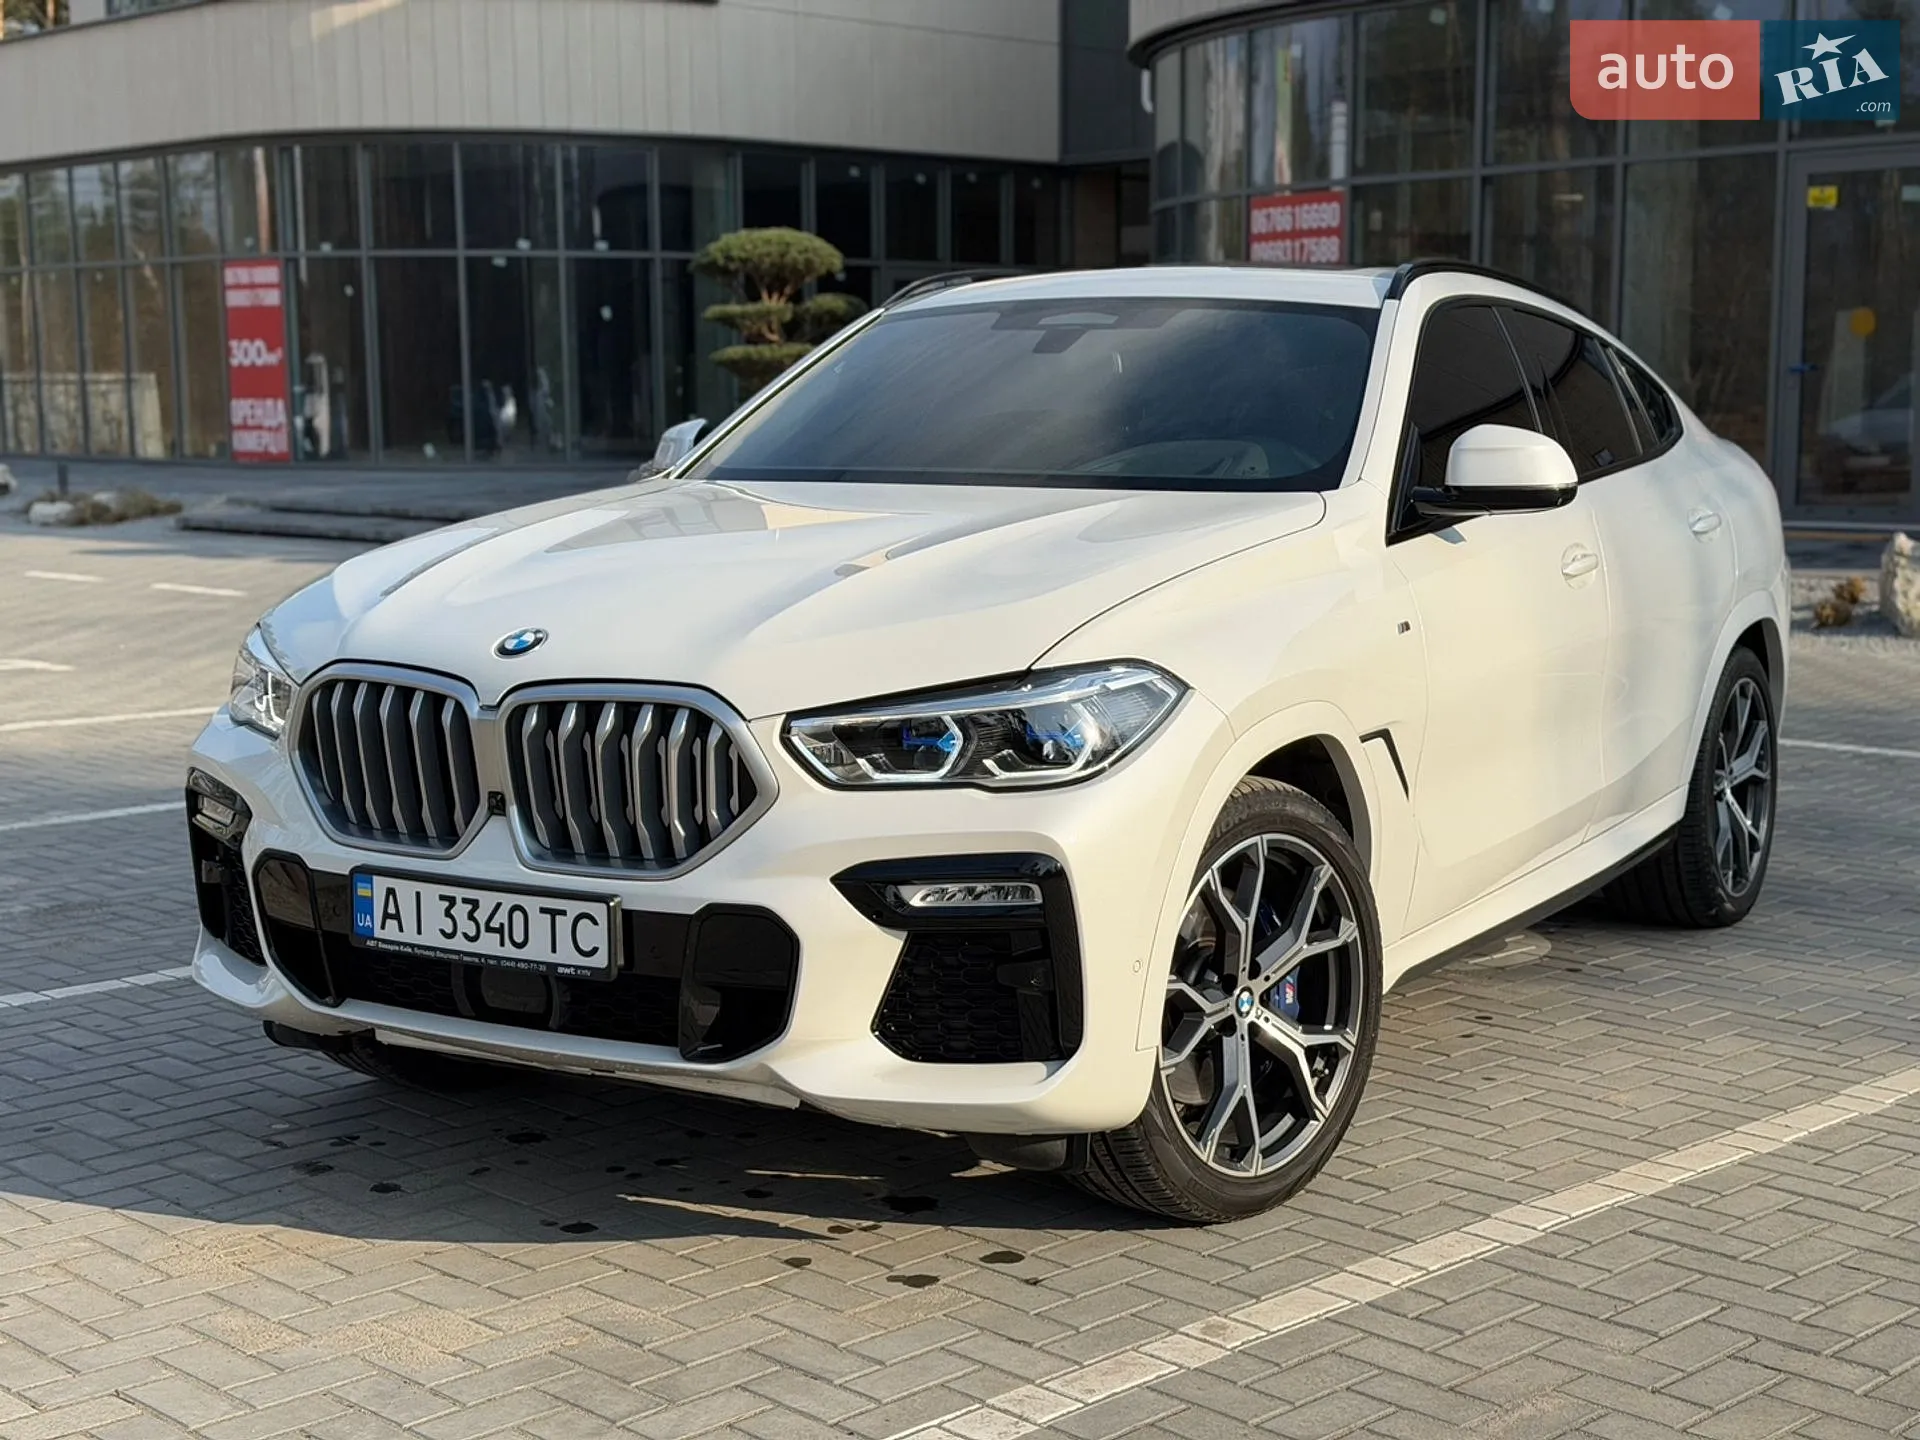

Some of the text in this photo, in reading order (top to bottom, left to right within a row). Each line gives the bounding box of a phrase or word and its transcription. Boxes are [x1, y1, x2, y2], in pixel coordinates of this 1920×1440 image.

[357, 912, 373, 929] UA
[380, 887, 600, 958] AI 3340 TC
